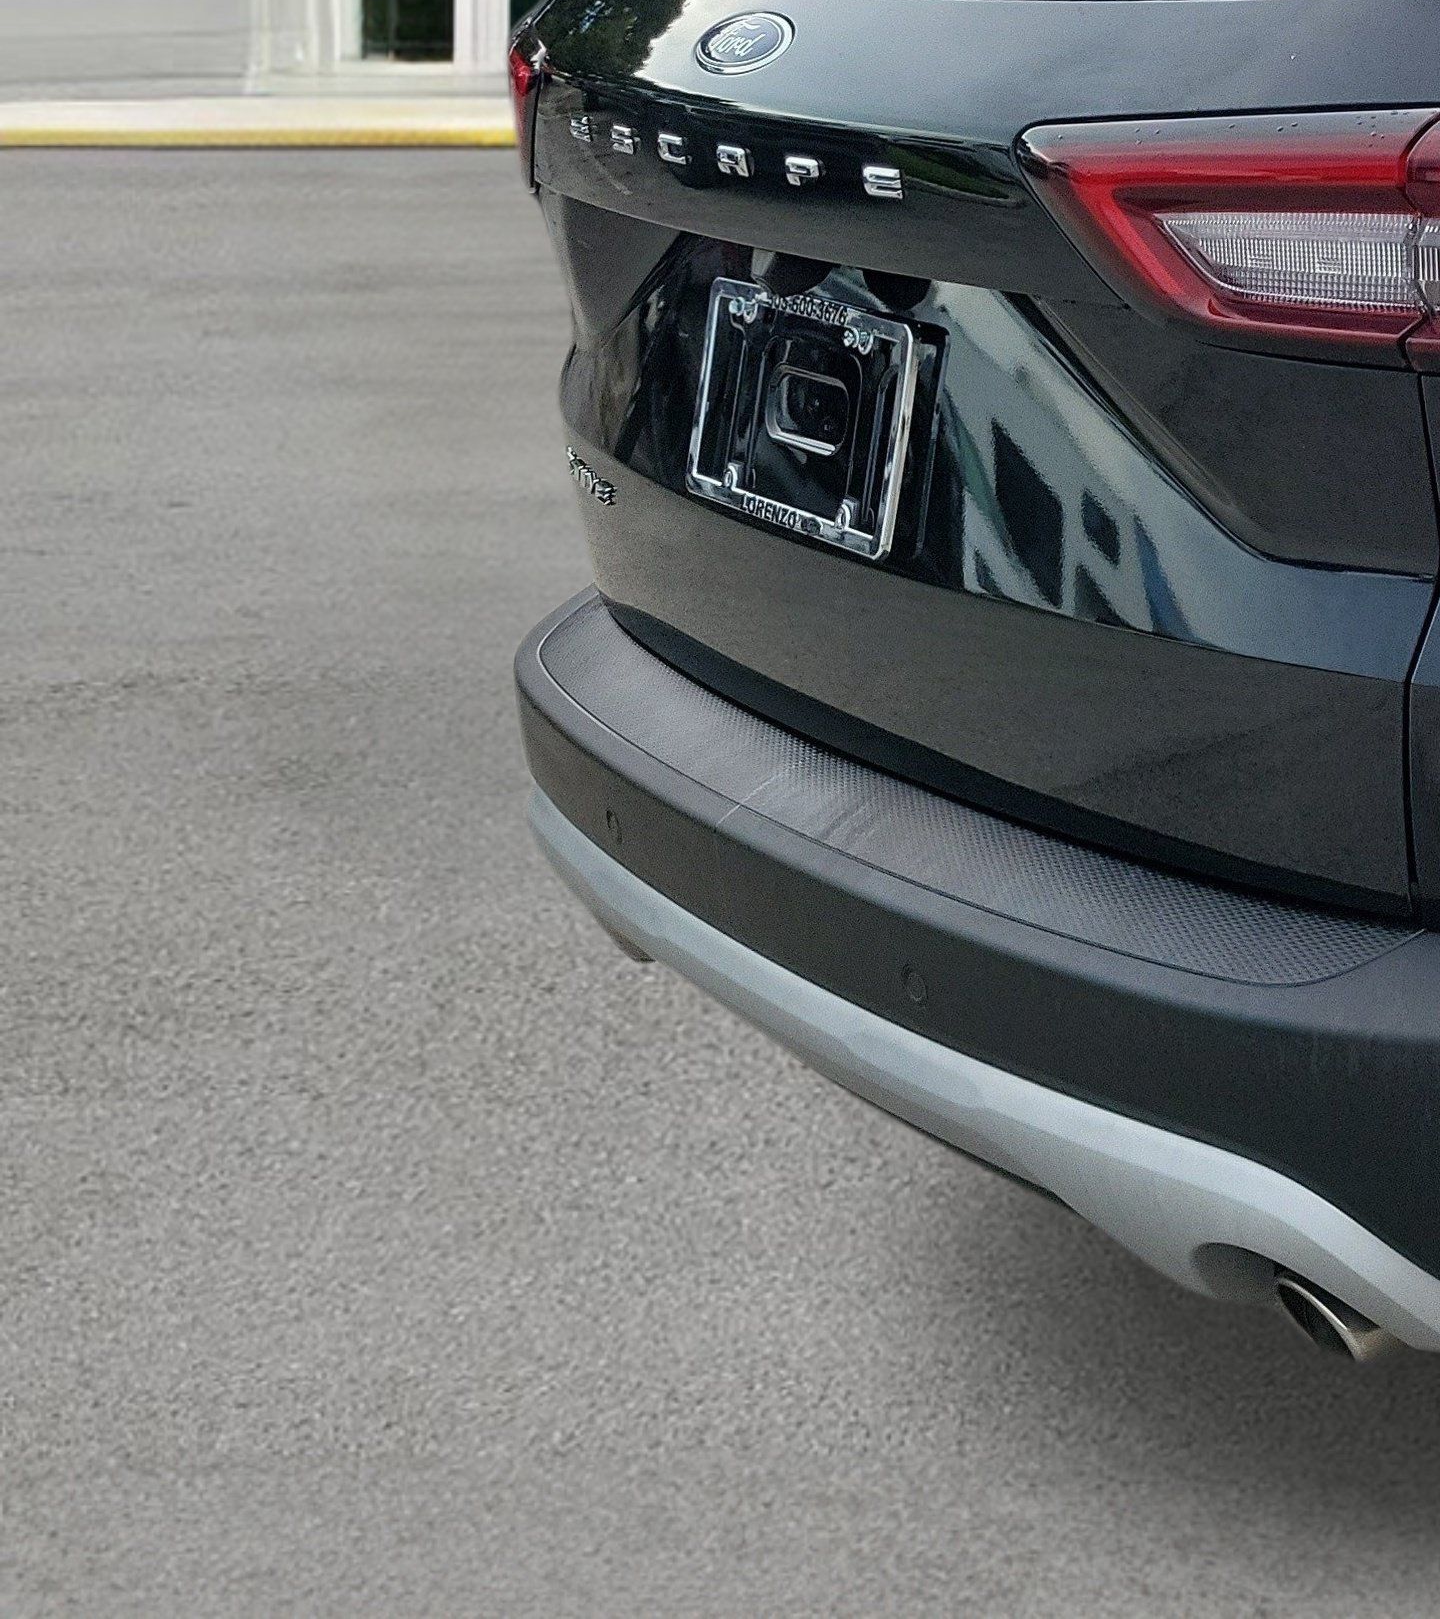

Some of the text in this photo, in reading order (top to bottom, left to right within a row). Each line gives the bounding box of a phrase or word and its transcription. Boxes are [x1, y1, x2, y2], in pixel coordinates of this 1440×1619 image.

[709, 20, 765, 57] Ford
[569, 115, 904, 199] ESCAPE
[740, 493, 799, 529] LORENZO
